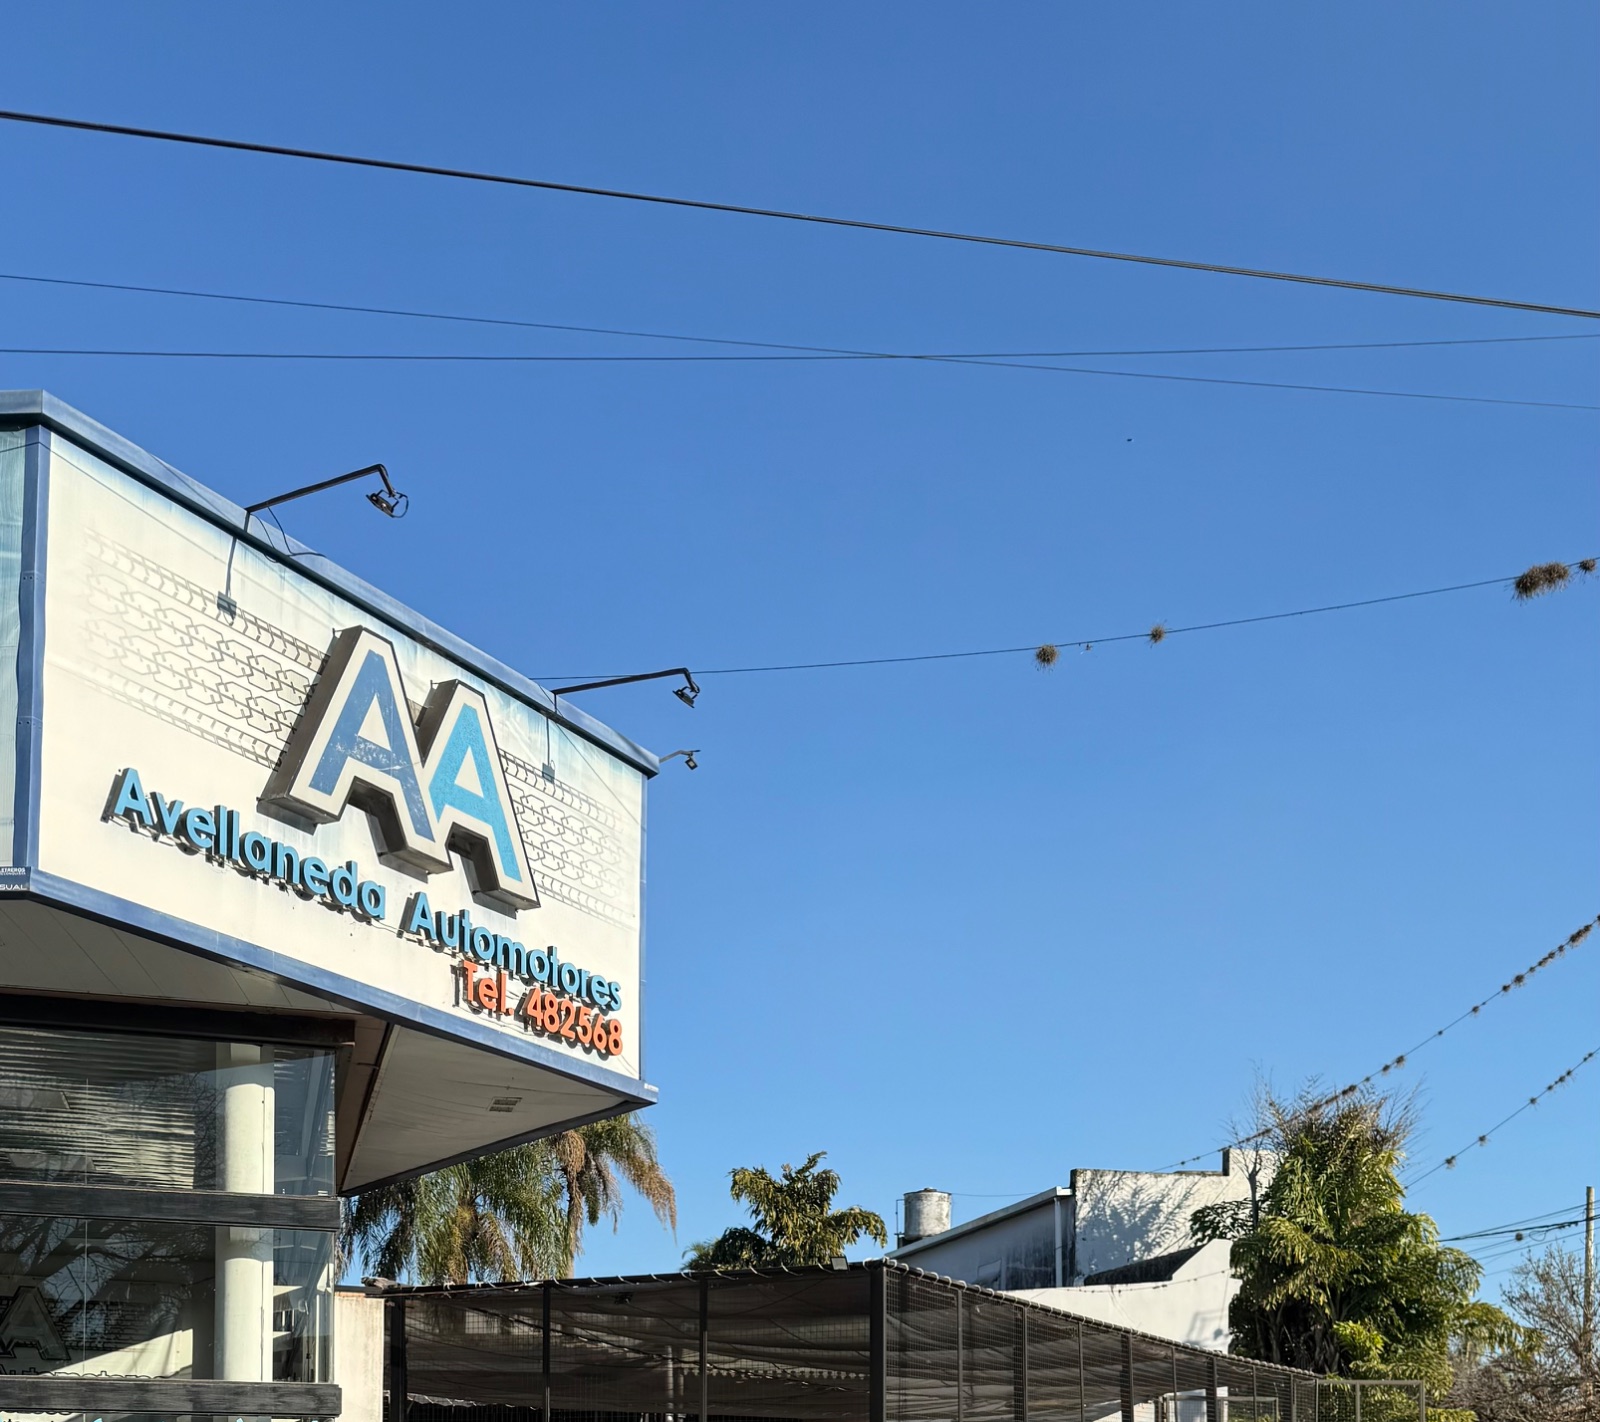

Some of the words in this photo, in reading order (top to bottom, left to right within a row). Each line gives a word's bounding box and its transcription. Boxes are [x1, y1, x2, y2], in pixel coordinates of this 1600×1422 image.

[110, 767, 387, 922] Avellaneda
[408, 891, 623, 1012] Automotores
[462, 960, 514, 1016] Tel.
[525, 988, 624, 1056] 482568
